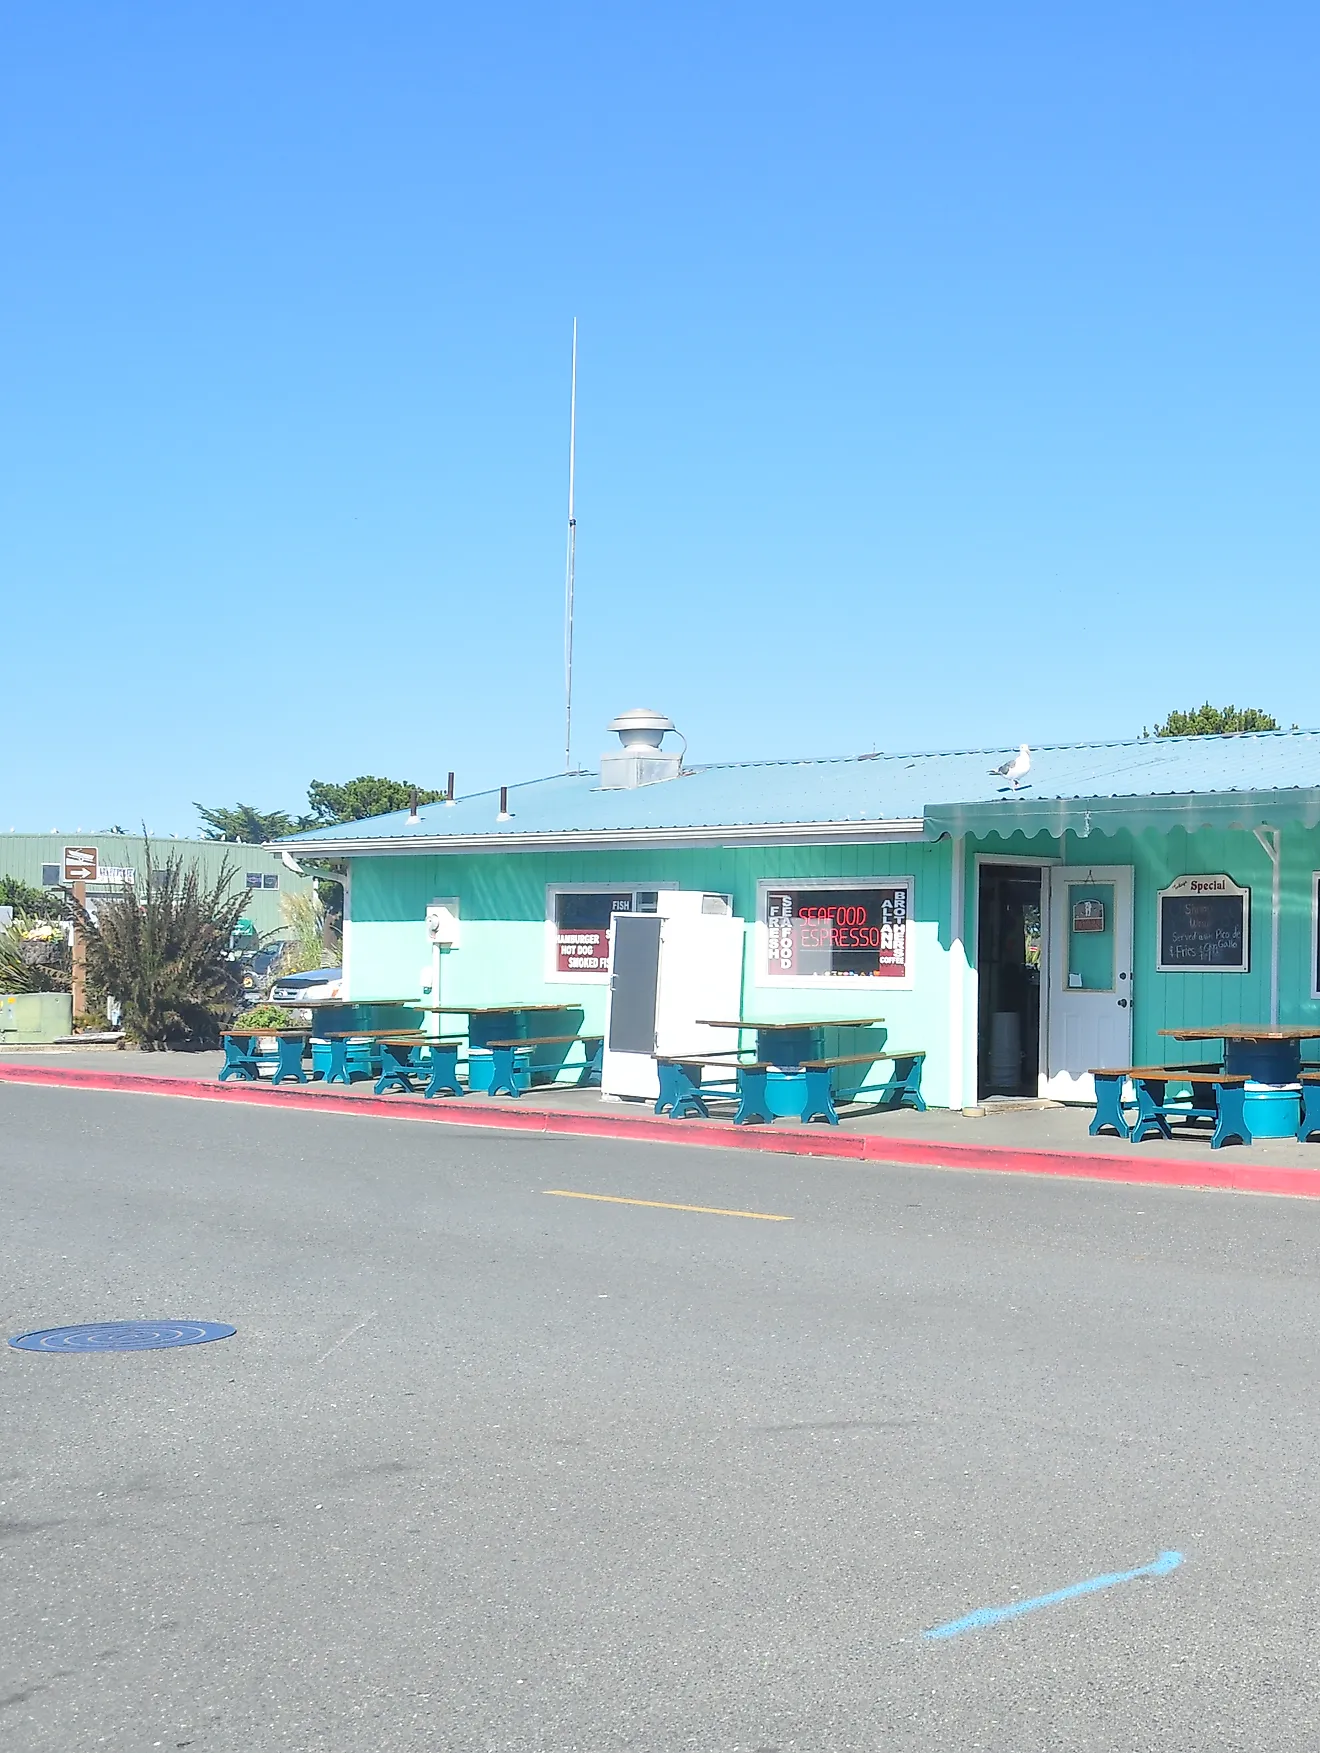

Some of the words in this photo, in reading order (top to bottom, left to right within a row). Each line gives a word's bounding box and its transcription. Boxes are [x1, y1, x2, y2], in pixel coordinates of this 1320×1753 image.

[1190, 880, 1226, 893] Special
[612, 901, 630, 911] FISH
[798, 906, 867, 926] SEAFOOD
[769, 906, 780, 960] FRESH
[780, 896, 793, 970] SEAFOOD
[894, 891, 906, 957] BROTHERS
[801, 927, 880, 947] ESPRESSO
[561, 945, 576, 955] HOT
[577, 945, 594, 955] DOG
[568, 957, 599, 969] SMOKED
